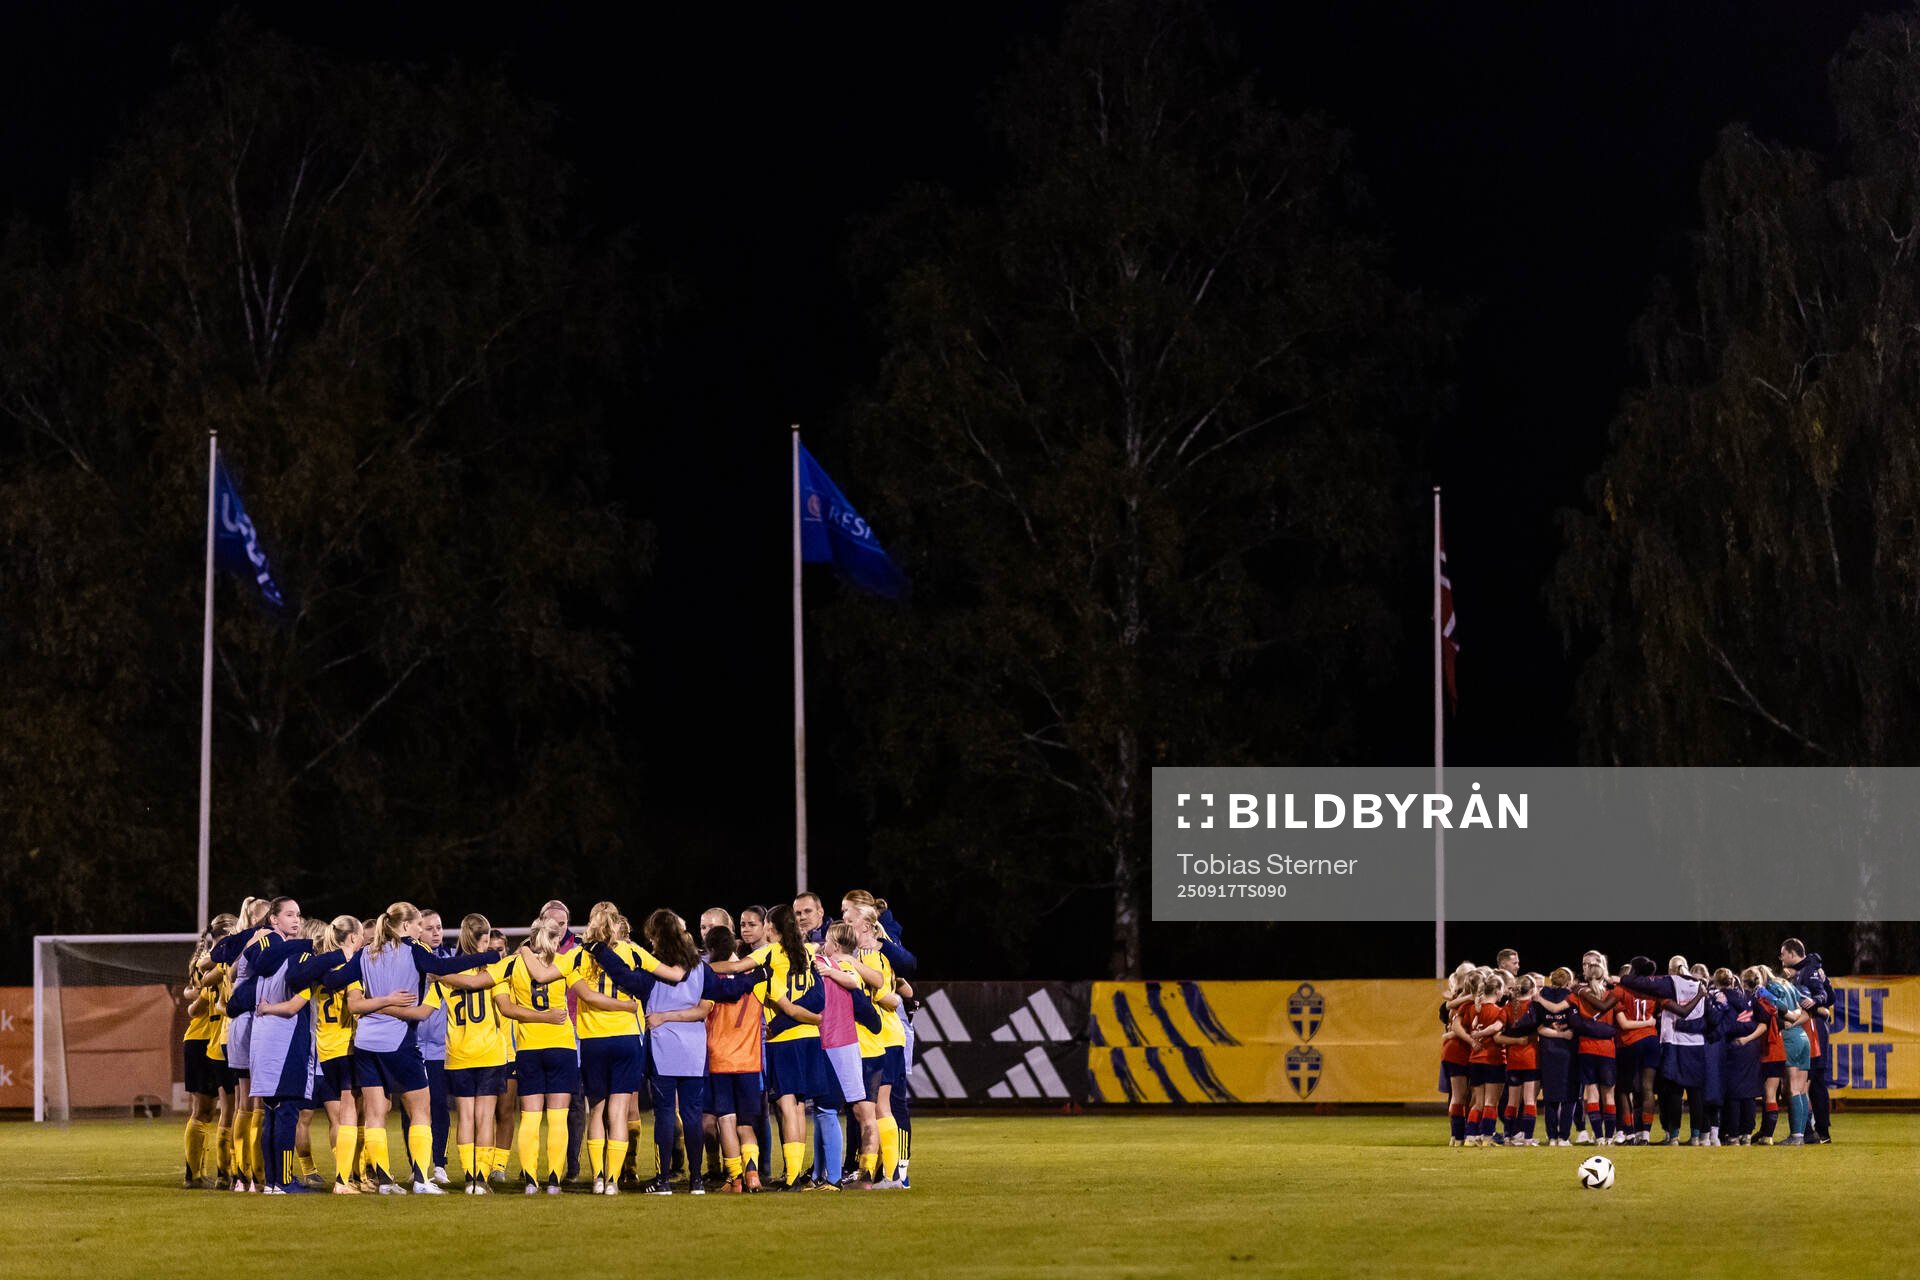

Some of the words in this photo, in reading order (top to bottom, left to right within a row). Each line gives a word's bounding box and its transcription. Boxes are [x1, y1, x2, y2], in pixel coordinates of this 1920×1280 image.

[450, 986, 487, 1026] 20
[530, 978, 550, 1012] 8
[1634, 998, 1647, 1022] 11
